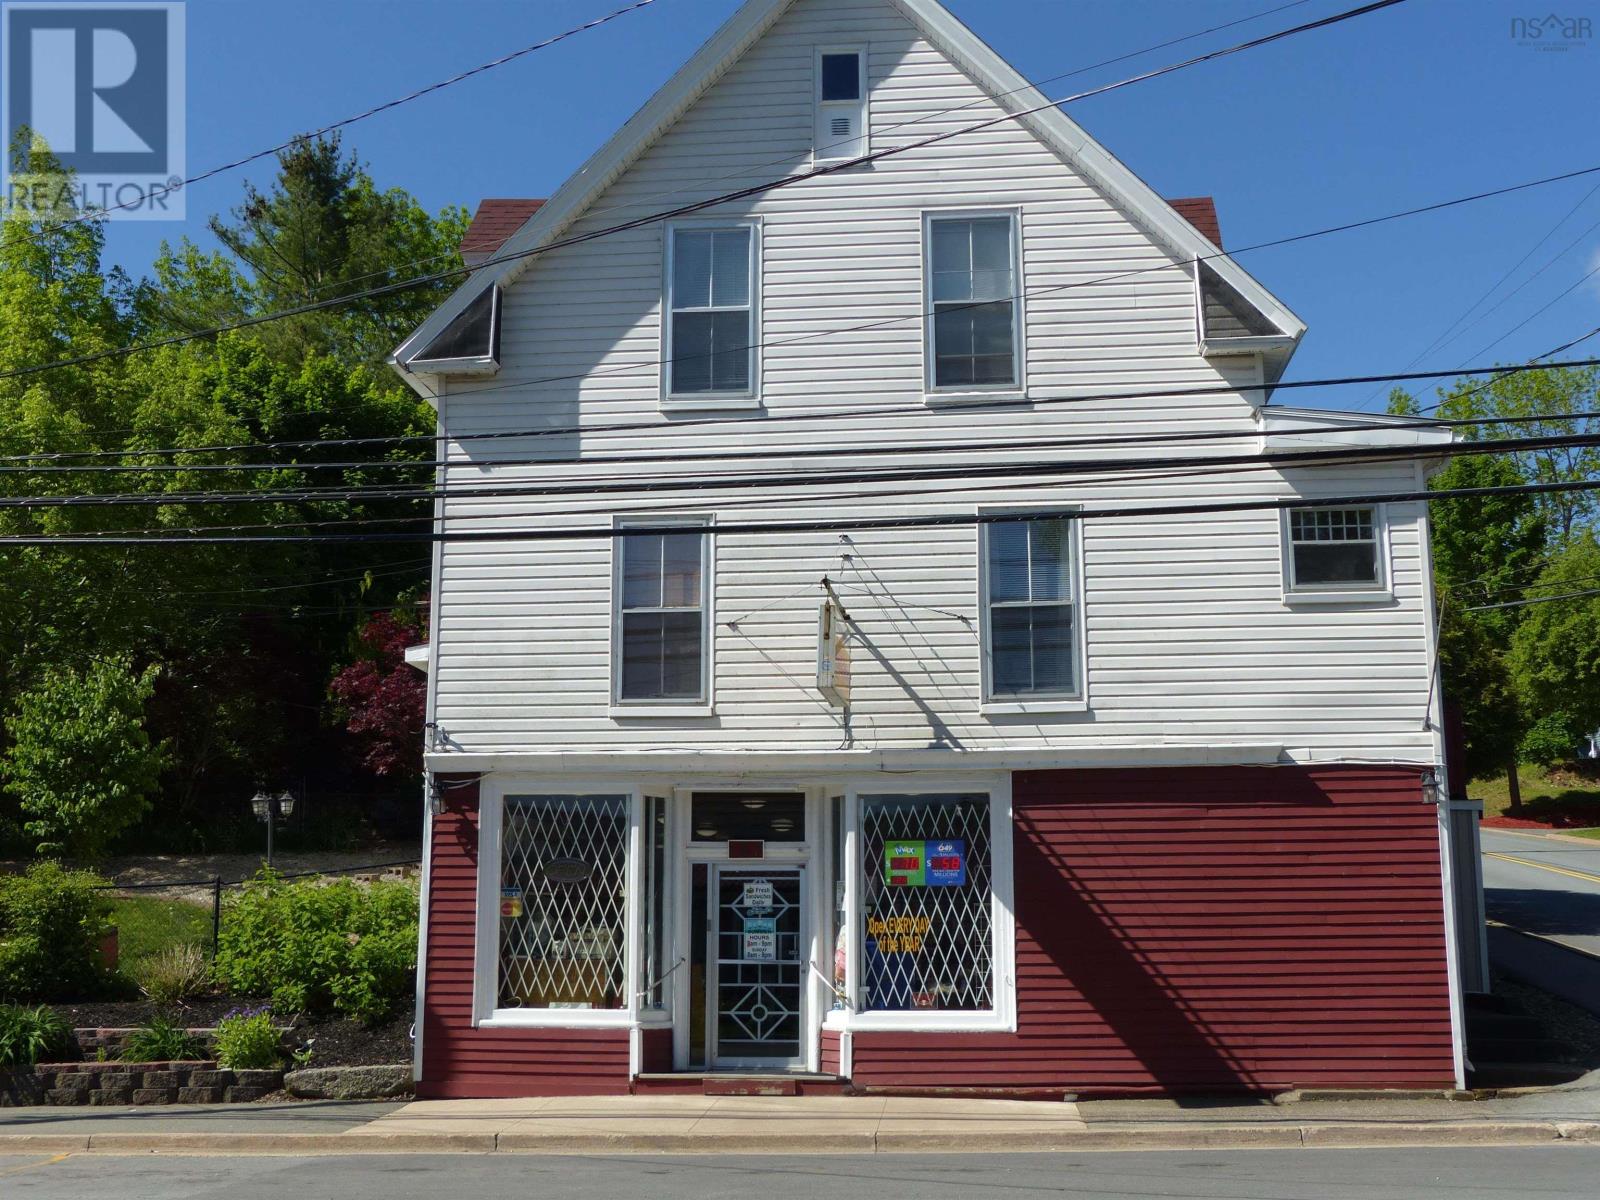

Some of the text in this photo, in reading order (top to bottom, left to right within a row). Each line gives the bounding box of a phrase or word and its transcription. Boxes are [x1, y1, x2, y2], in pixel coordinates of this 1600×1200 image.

[869, 917, 930, 934] Open EVERY DAY
[878, 935, 920, 952] of the YEAR
